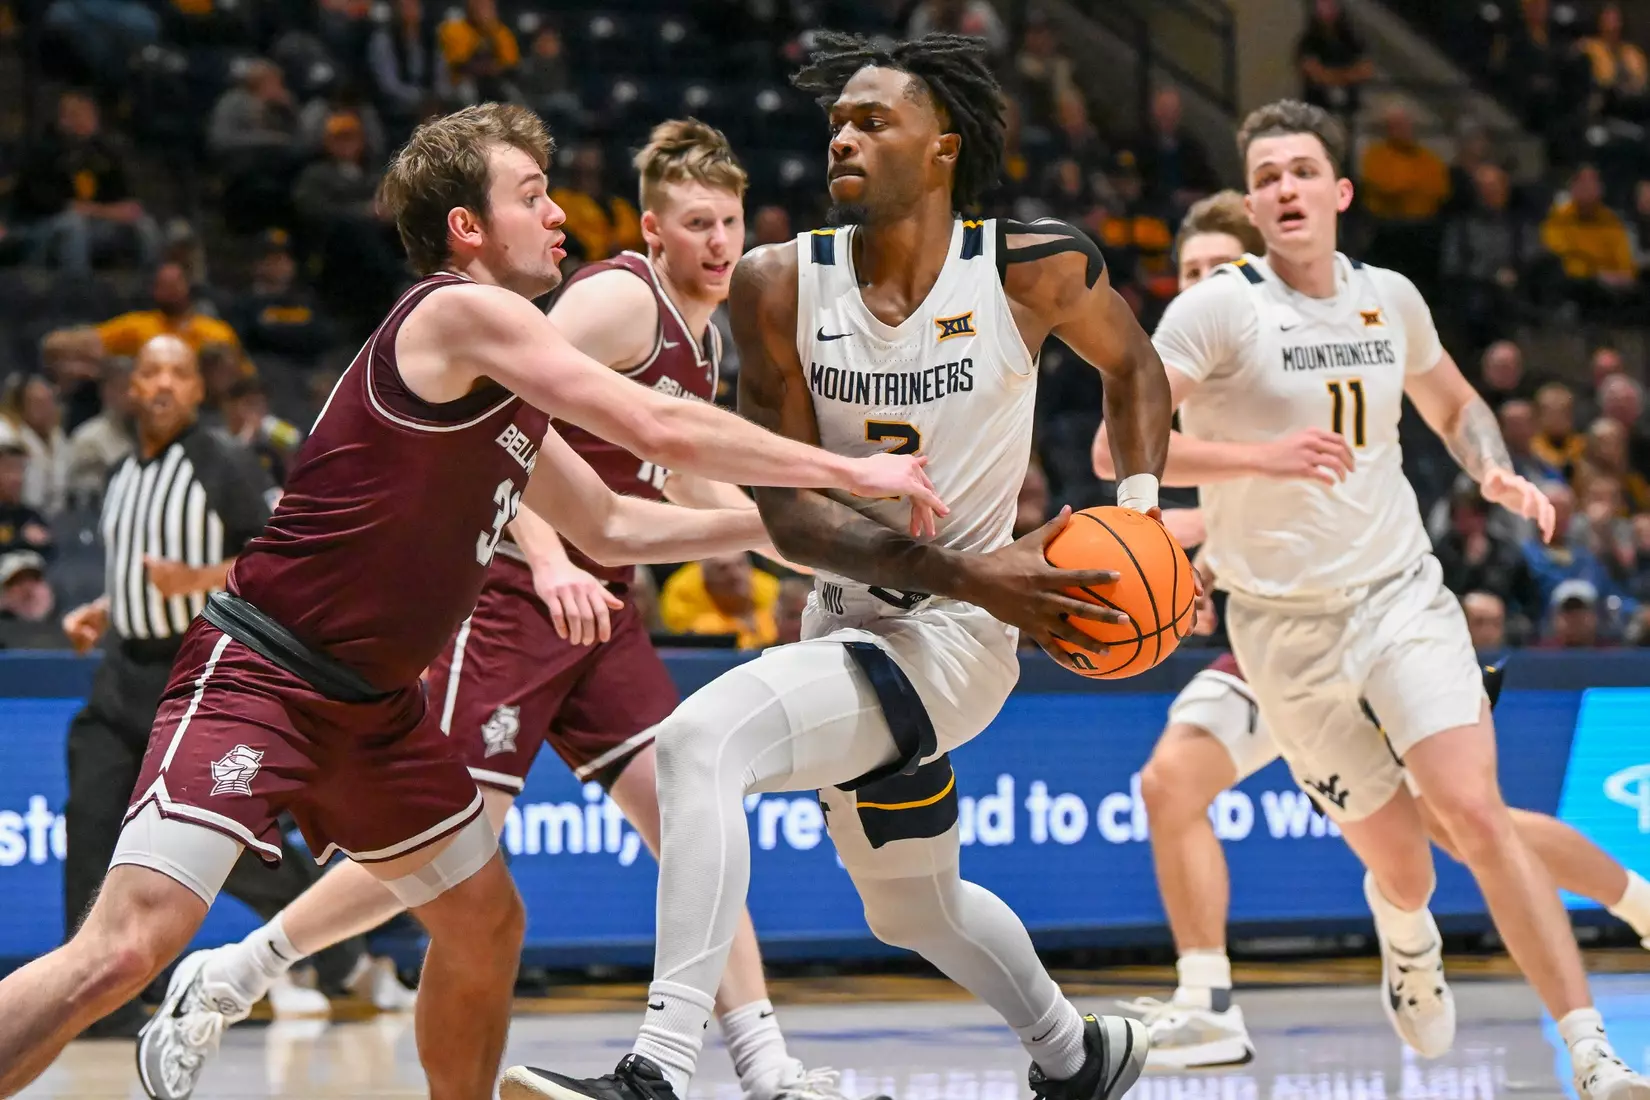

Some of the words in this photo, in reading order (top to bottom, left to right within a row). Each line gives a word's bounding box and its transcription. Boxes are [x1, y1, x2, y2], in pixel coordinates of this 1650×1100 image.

[937, 312, 975, 340] XII
[1281, 340, 1395, 371] MOUNTAINEERS
[810, 358, 974, 405] MOUNTAINEERS
[1326, 376, 1366, 447] 11
[1024, 780, 1089, 844] to
